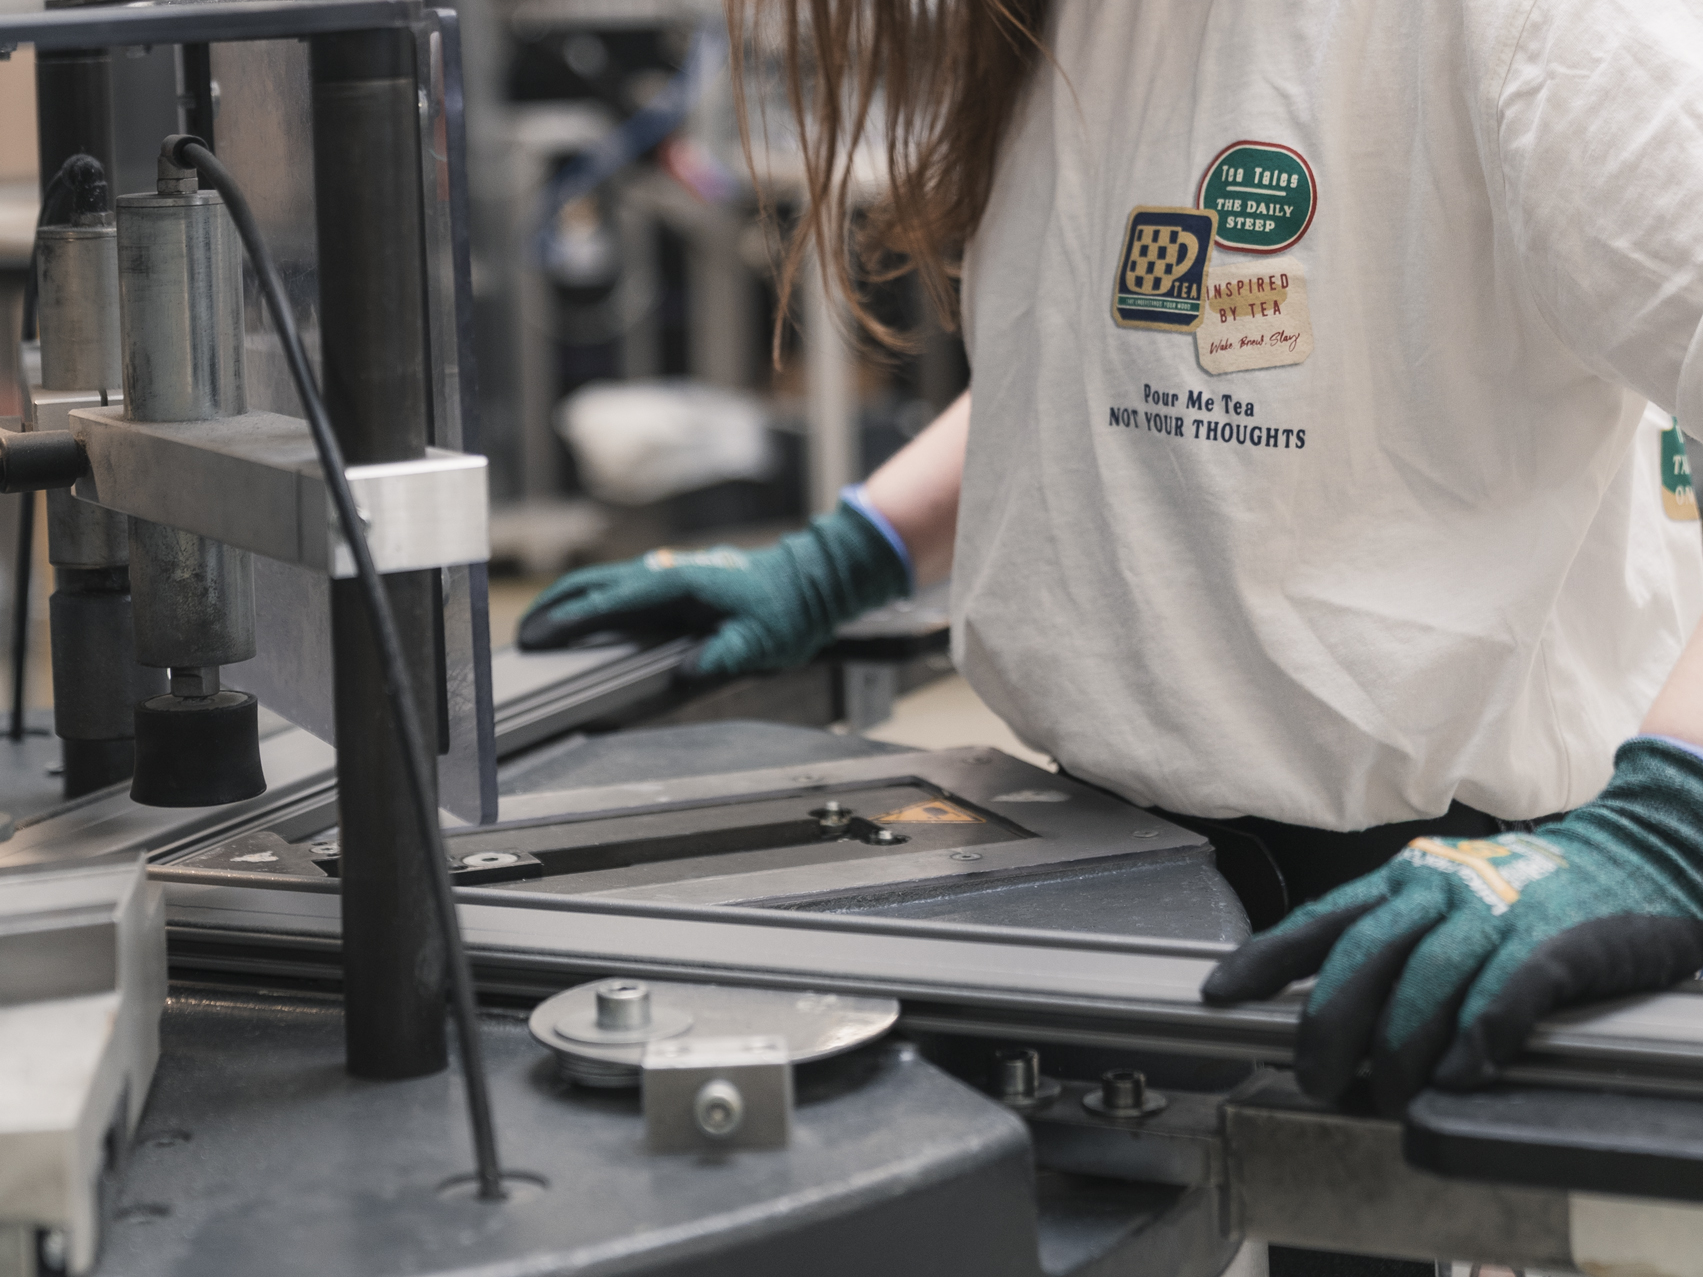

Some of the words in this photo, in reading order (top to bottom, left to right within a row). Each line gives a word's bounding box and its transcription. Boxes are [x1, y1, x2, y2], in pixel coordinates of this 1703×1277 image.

[1221, 165, 1244, 182] Tea
[1254, 167, 1299, 188] Tales
[1216, 198, 1242, 212] THE
[1246, 200, 1294, 217] DAILY
[1226, 216, 1276, 232] STEEP
[1173, 281, 1198, 299] TEA
[1206, 273, 1289, 301] INSPIRED
[1219, 305, 1237, 324] BY
[1247, 299, 1281, 319] TEA
[1269, 329, 1300, 353] Slay
[1143, 383, 1179, 408] Pour
[1186, 389, 1215, 412] Me
[1221, 394, 1255, 417] Tea
[1108, 407, 1139, 429] NOT
[1143, 411, 1184, 438] YOUR
[1192, 419, 1306, 449] THOUGHTS
